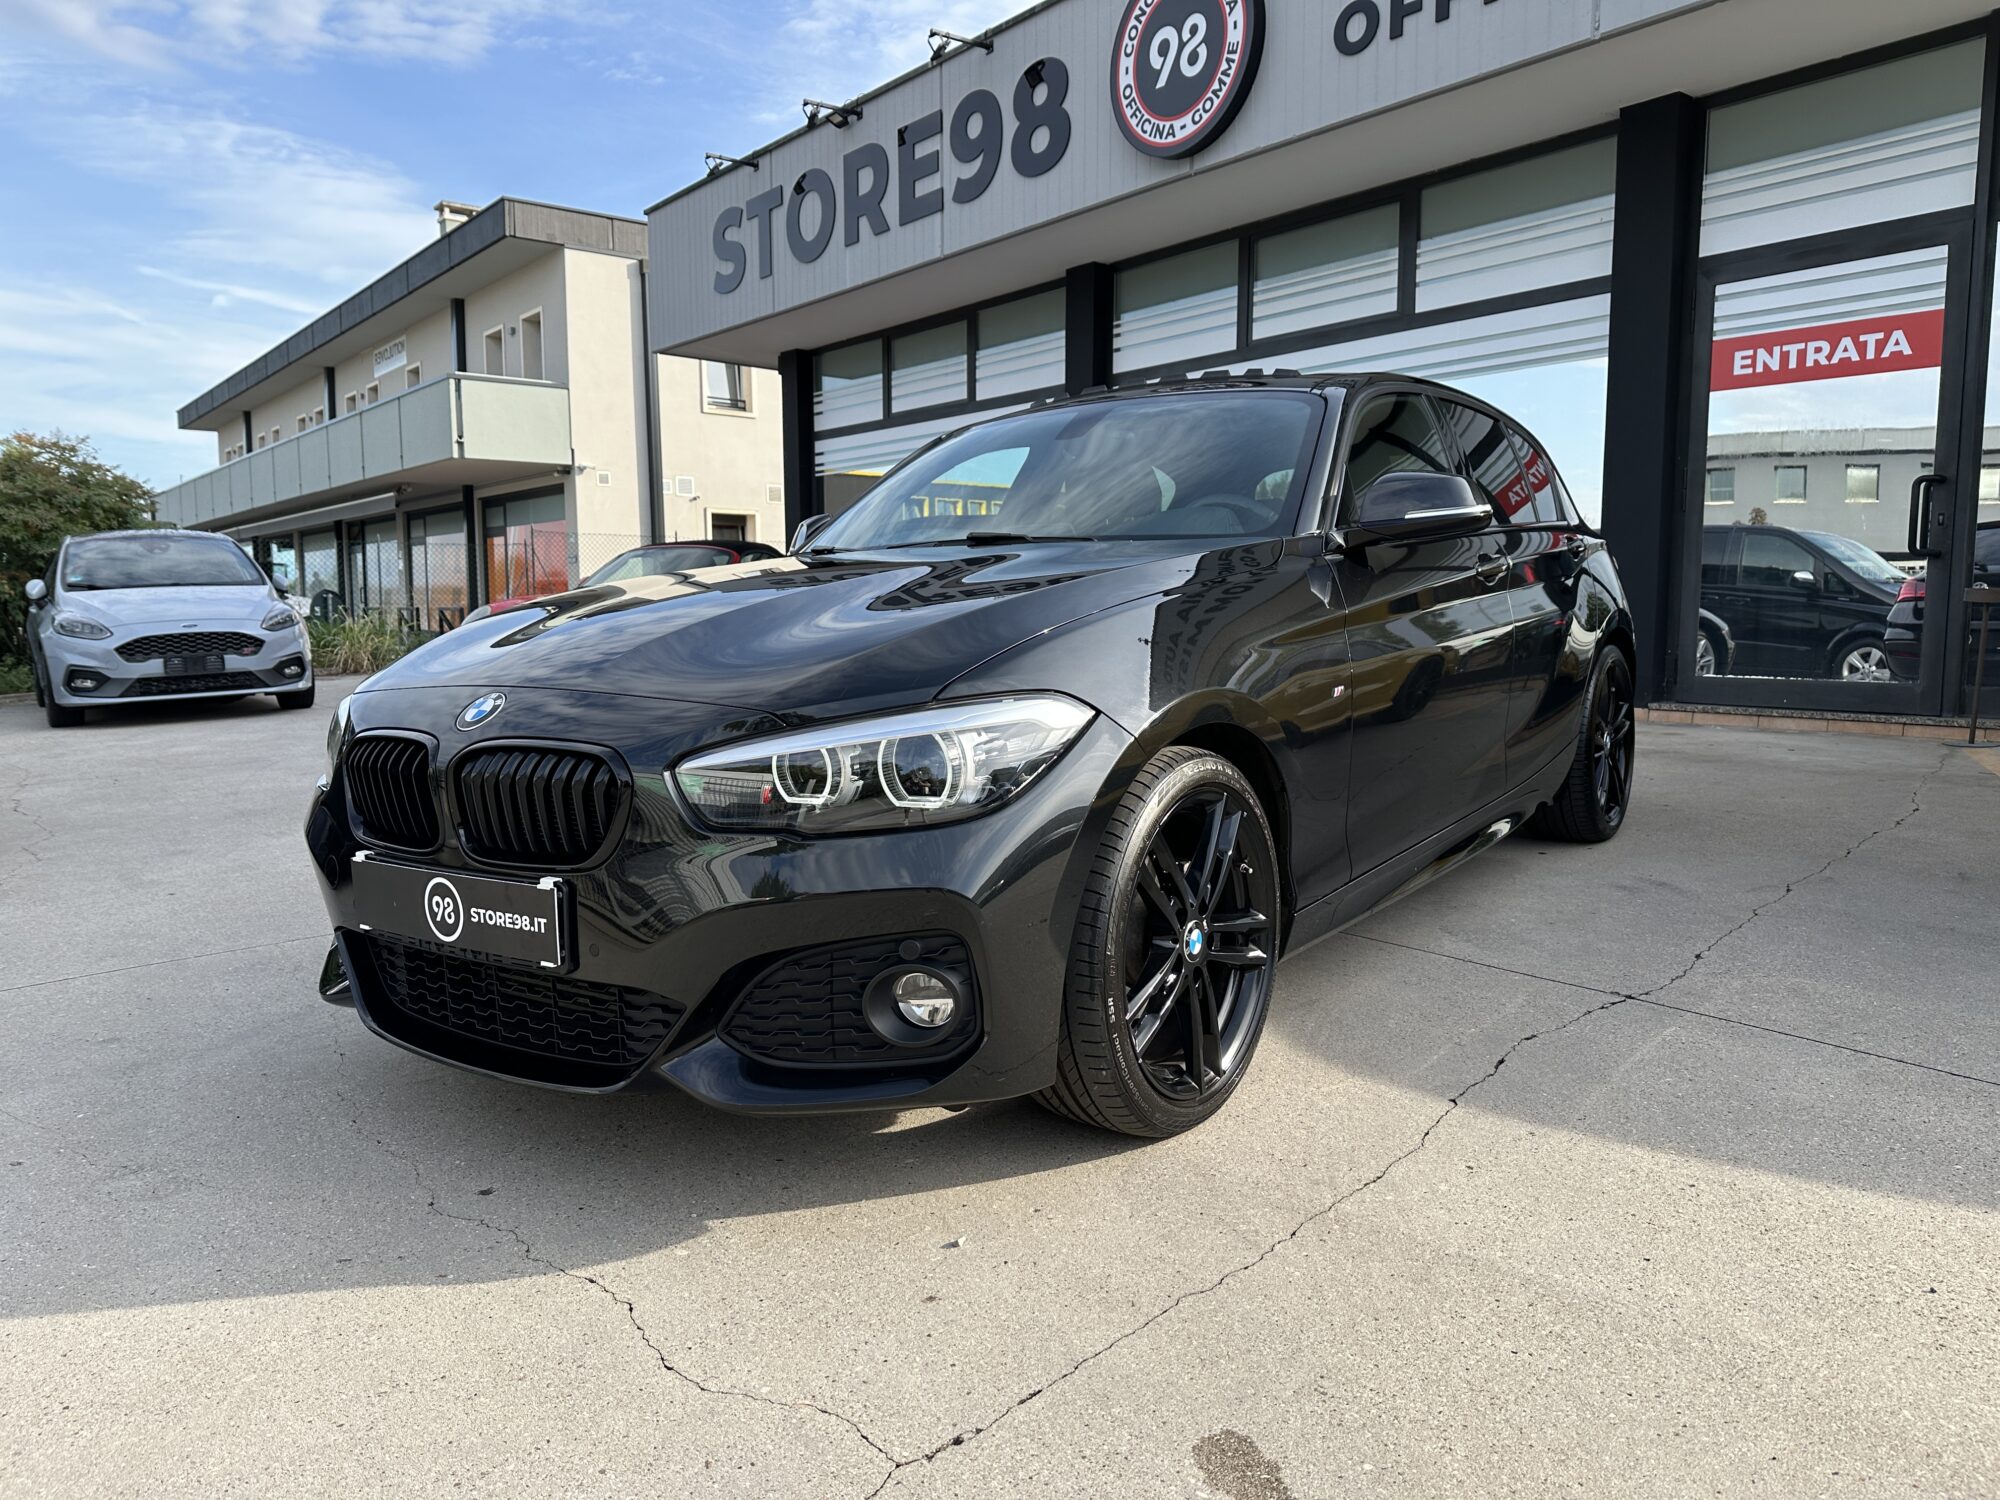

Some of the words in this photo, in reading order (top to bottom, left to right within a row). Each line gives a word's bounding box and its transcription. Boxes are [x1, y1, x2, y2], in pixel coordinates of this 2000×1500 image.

[1150, 12, 1208, 90] 98
[1122, 83, 1177, 140] OFFICINA
[1191, 40, 1240, 127] GOMME
[712, 56, 1072, 295] STORE98
[1733, 329, 1913, 376] ENTRATA
[431, 895, 456, 925] 98
[470, 907, 547, 934] STORE98.IT
[1107, 997, 1116, 1024] SSR
